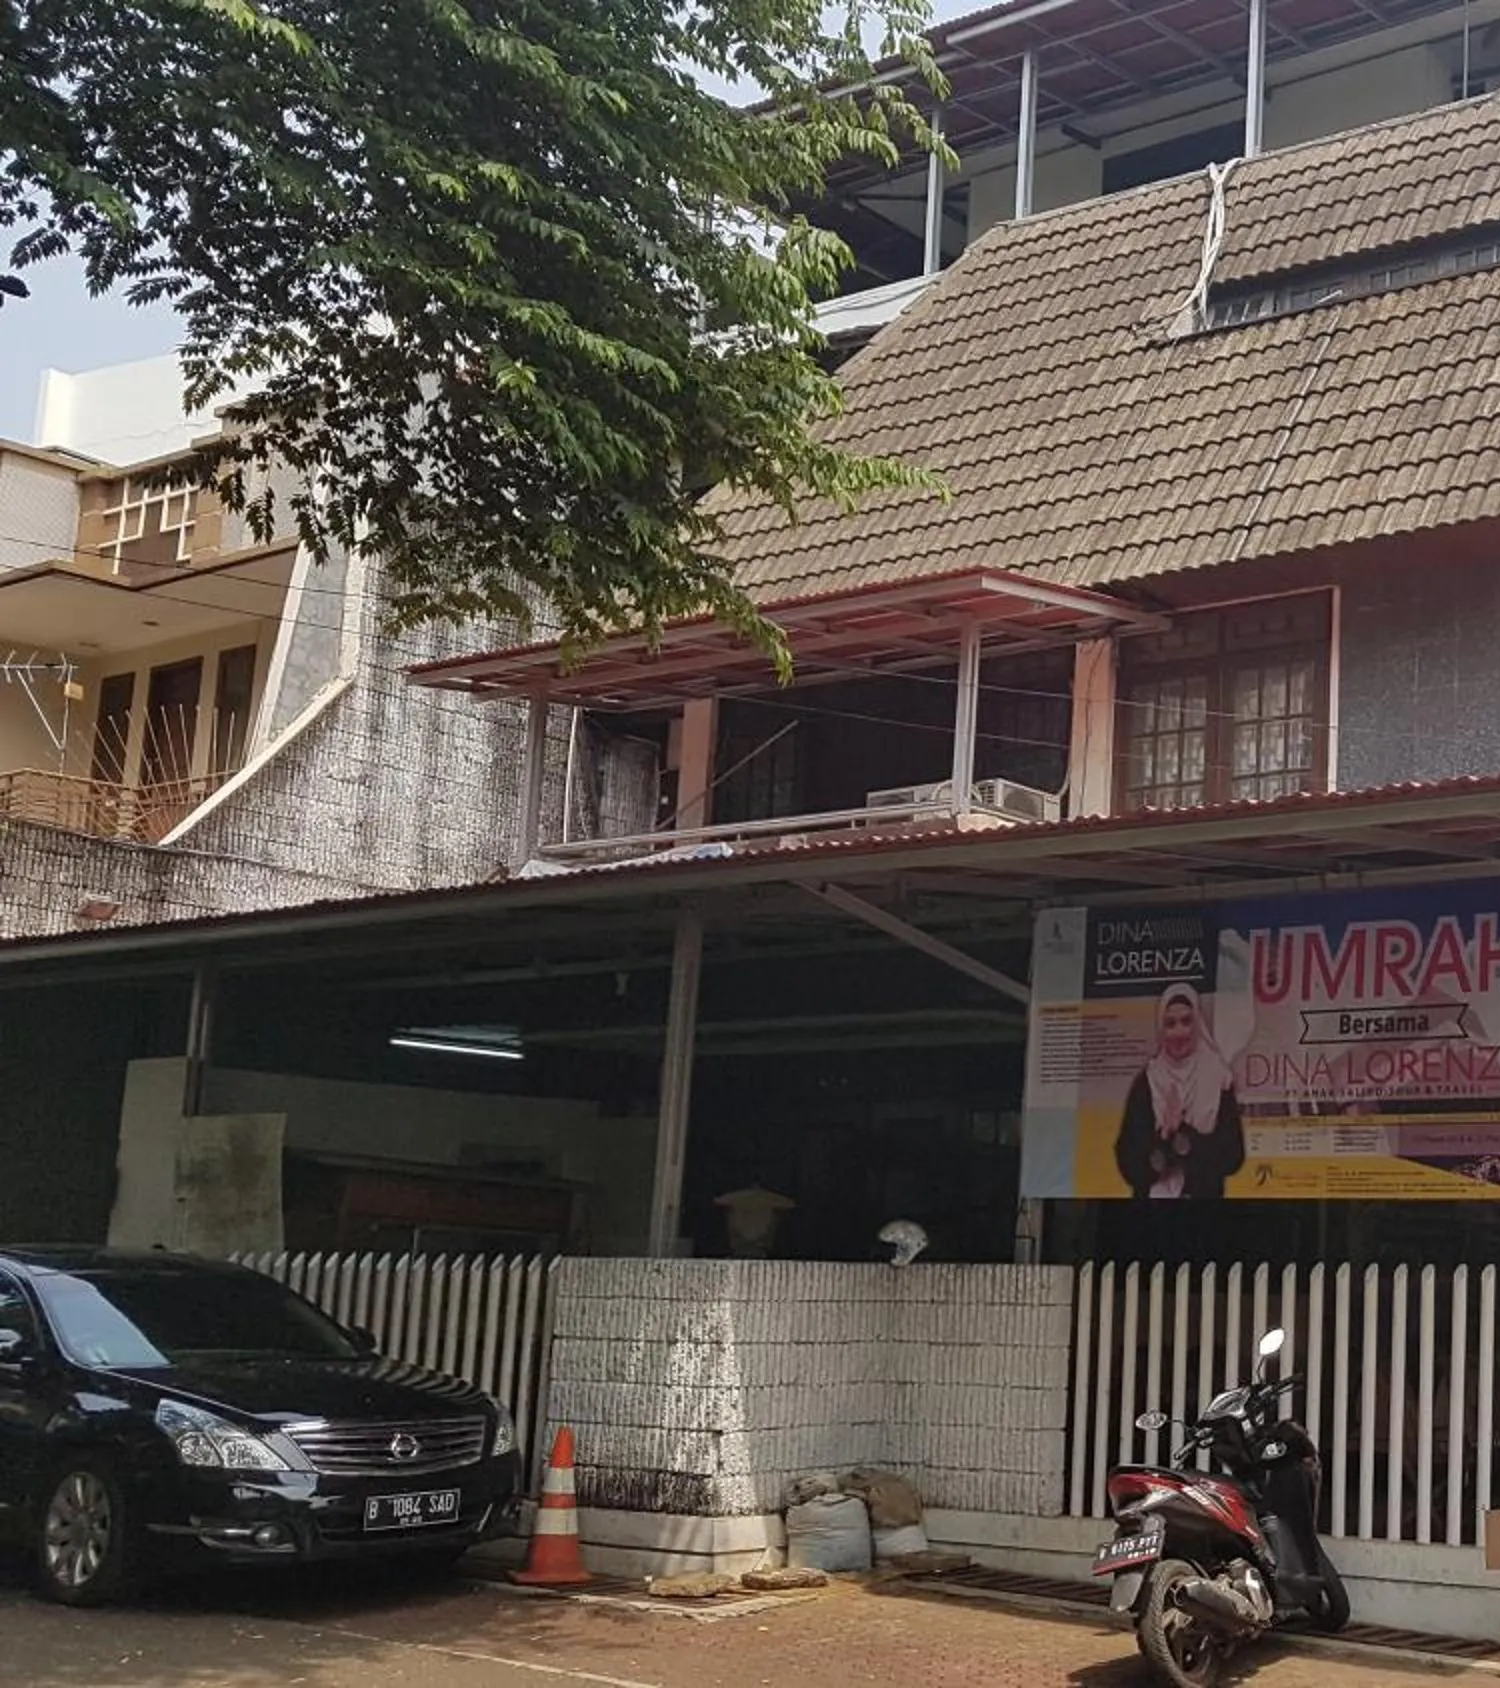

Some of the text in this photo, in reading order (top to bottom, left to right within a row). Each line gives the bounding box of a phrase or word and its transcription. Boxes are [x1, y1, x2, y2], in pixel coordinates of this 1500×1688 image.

[1098, 920, 1154, 945] DINA
[1097, 948, 1205, 975] LORENZA
[1339, 1013, 1429, 1035] Bersama
[1246, 1052, 1334, 1088] DINA
[369, 1501, 378, 1519] B
